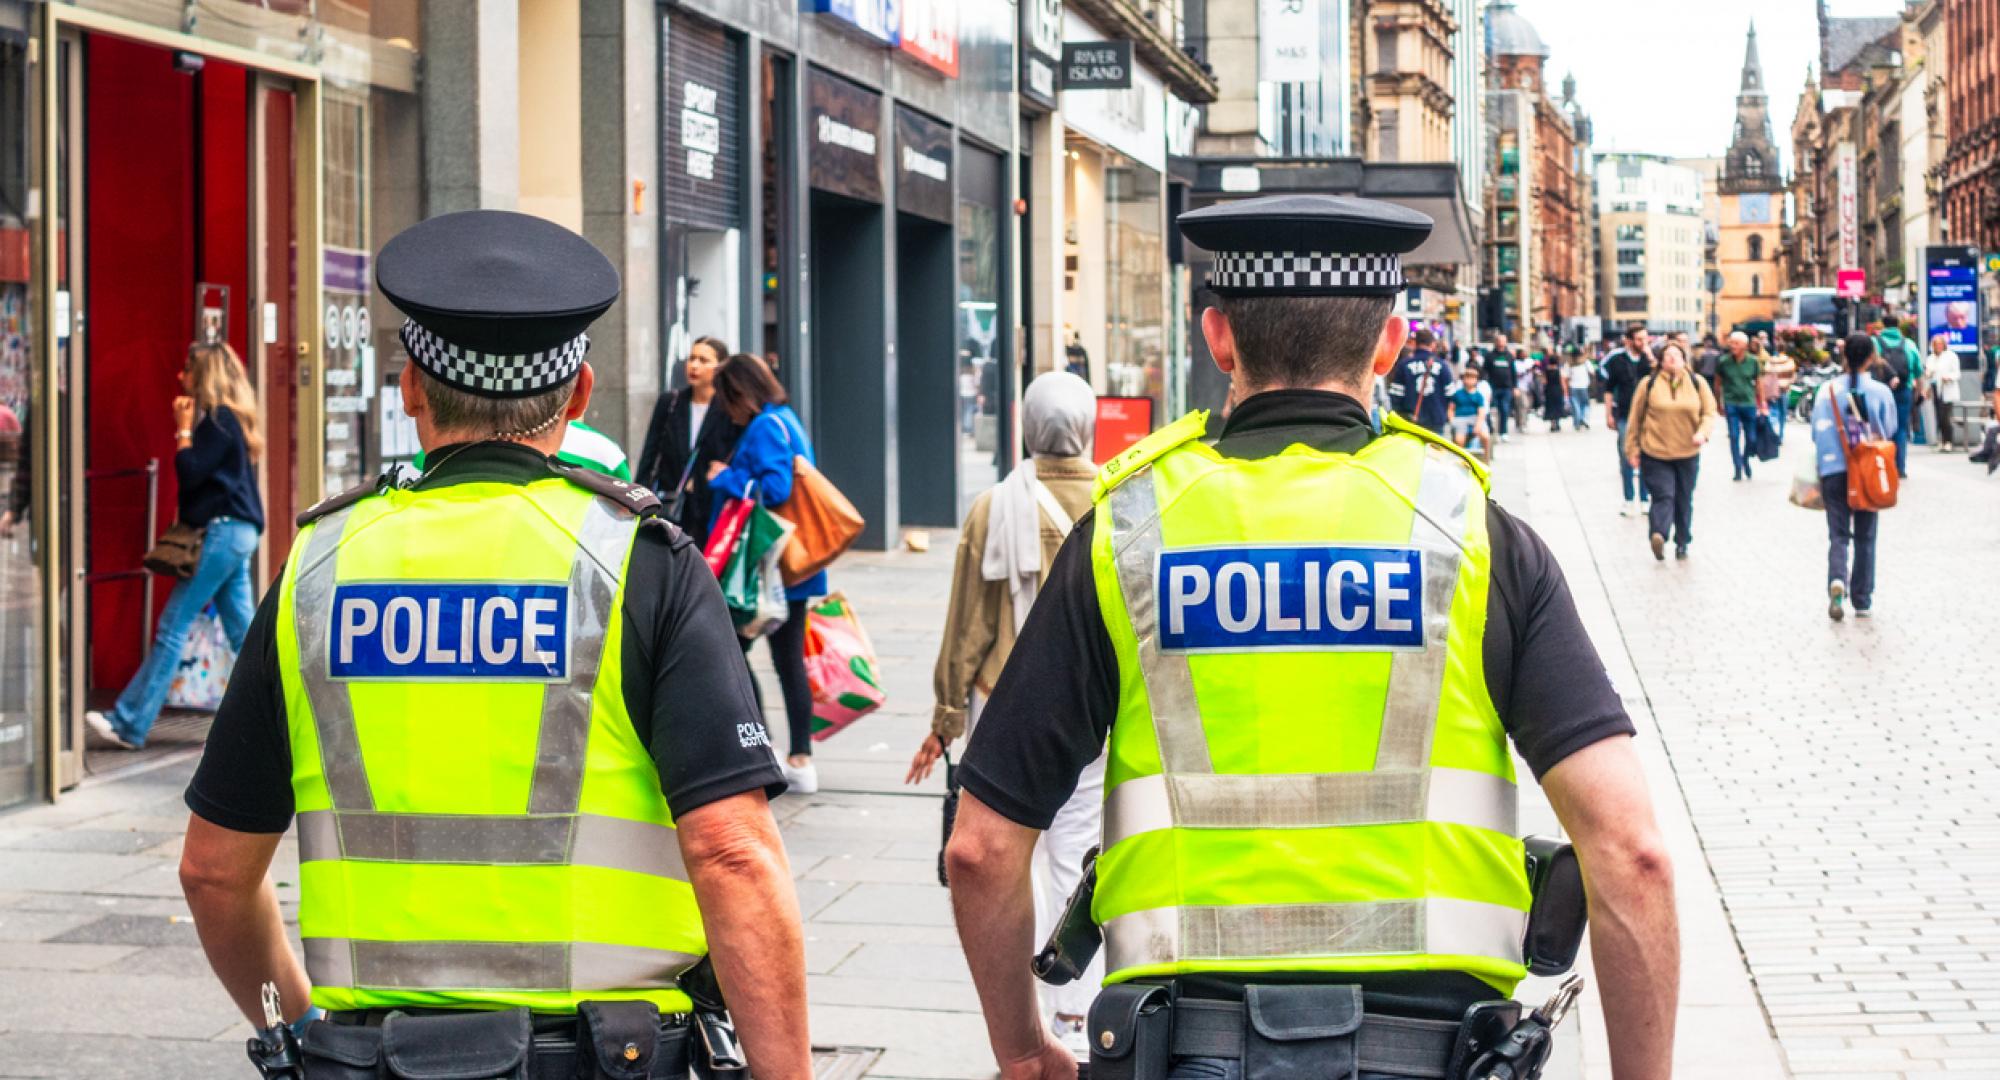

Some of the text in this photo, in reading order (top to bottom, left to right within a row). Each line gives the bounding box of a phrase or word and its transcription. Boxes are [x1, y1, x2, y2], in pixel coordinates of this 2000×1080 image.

[1074, 49, 1117, 64] RIVER
[1276, 46, 1308, 58] M&S
[1068, 65, 1123, 80] ISLAND
[1169, 560, 1412, 635] POLICE
[339, 596, 558, 665] POLICE
